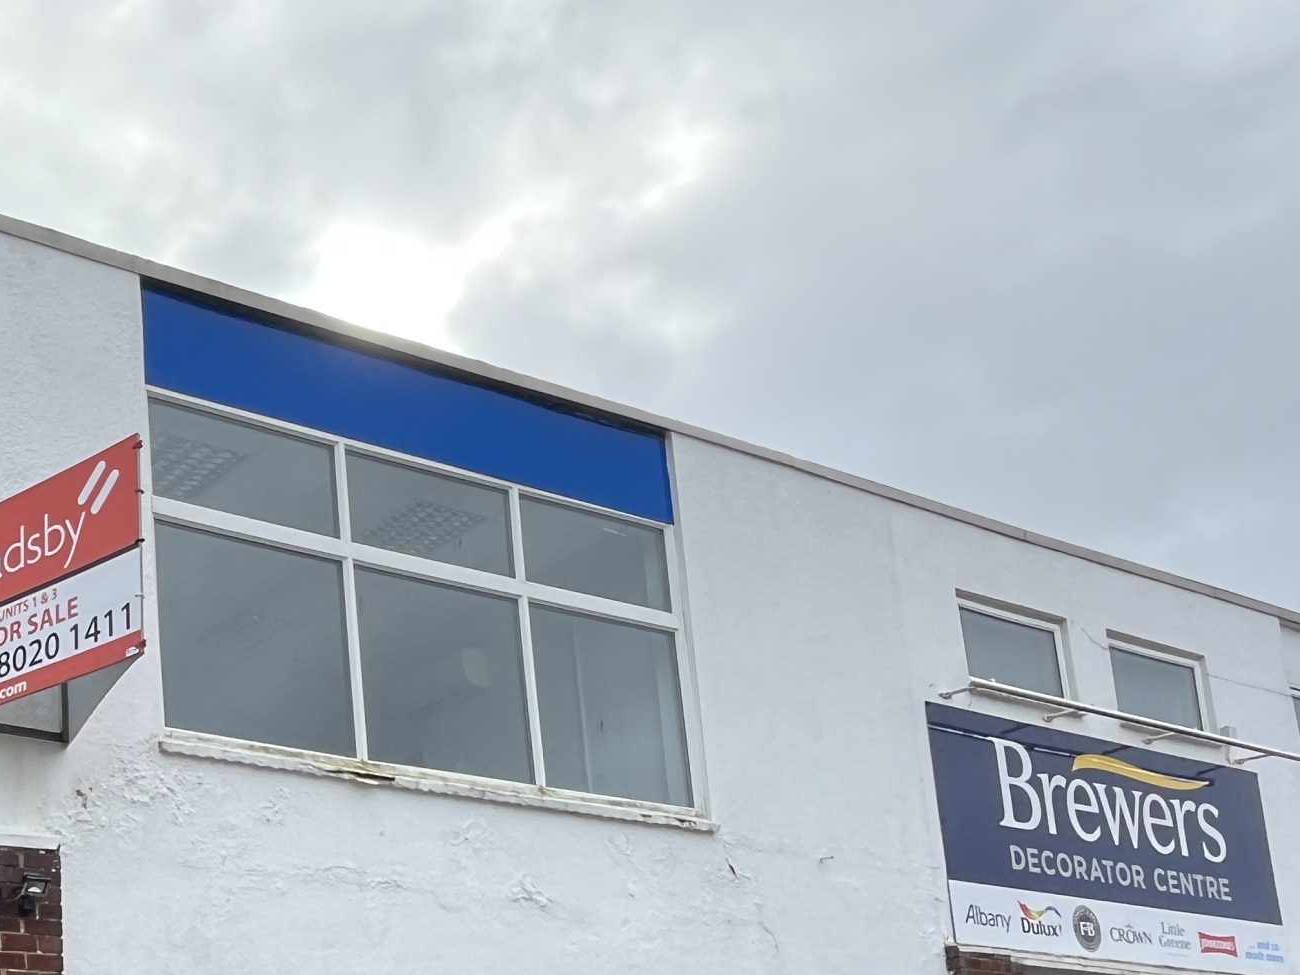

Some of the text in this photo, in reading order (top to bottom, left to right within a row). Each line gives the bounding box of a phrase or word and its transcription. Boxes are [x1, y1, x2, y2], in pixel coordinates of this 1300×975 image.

[41, 592, 48, 604] &
[51, 588, 57, 600] 3
[27, 596, 79, 635] SALE
[70, 602, 131, 650] 1411
[988, 736, 1227, 863] Brewers
[1009, 844, 1232, 901] DECORATOR CENTRE
[965, 904, 1012, 933] Albany
[1020, 917, 1060, 937] Dulux
[1110, 927, 1152, 945] CROWN
